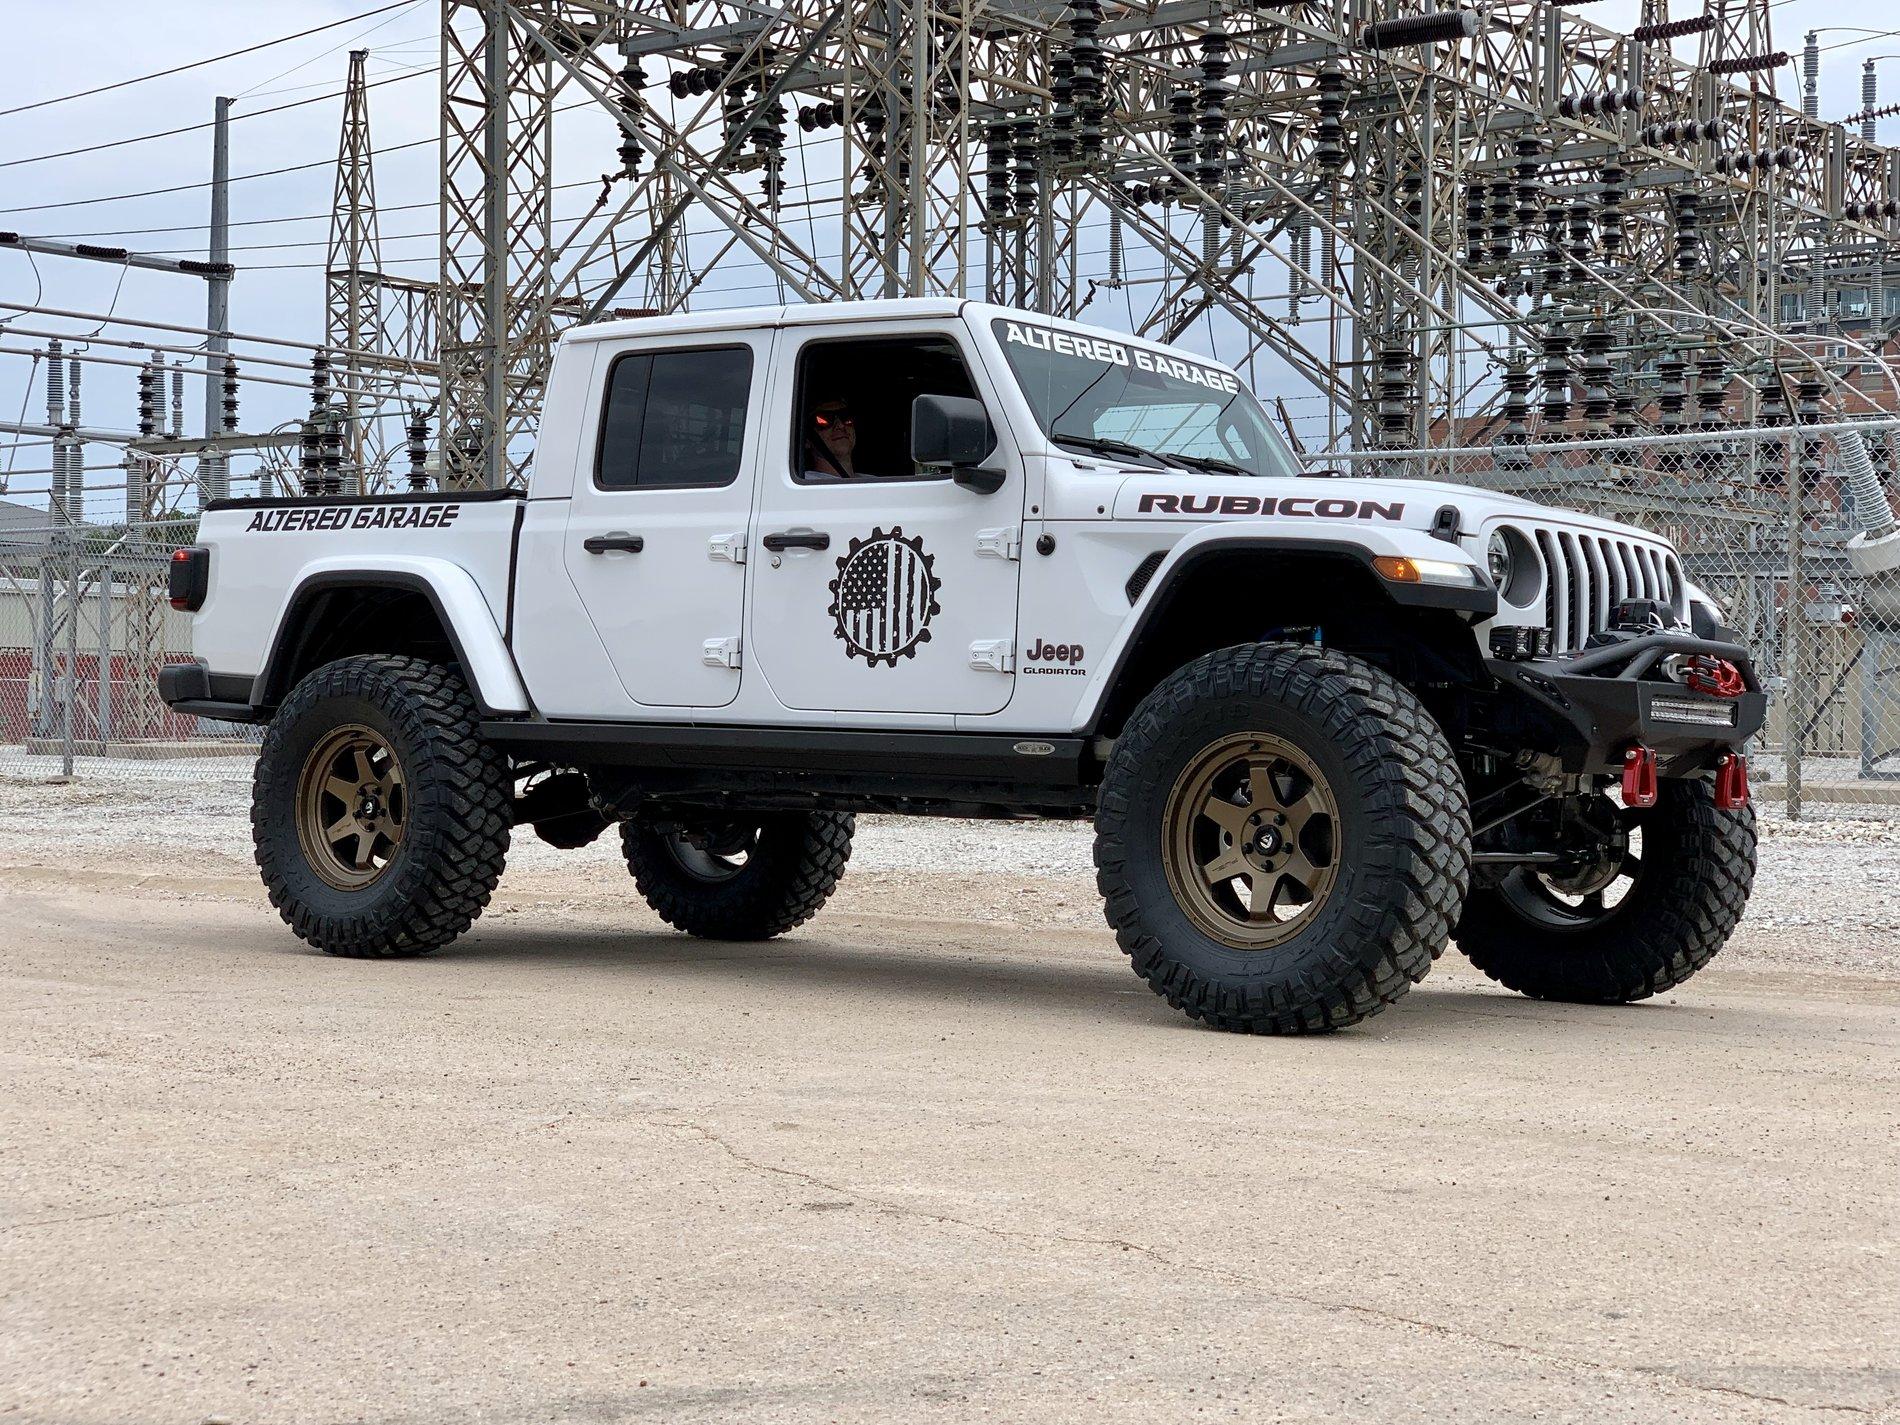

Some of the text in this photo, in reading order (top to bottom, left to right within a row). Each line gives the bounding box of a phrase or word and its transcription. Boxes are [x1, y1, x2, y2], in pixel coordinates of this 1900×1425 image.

[1006, 322, 1240, 395] ALTERED GARAGE
[245, 504, 461, 532] ALTERED GARAGE
[1137, 494, 1406, 521] RUBICON
[1026, 638, 1085, 666] Jeep
[1023, 667, 1087, 676] GLADIATOR
